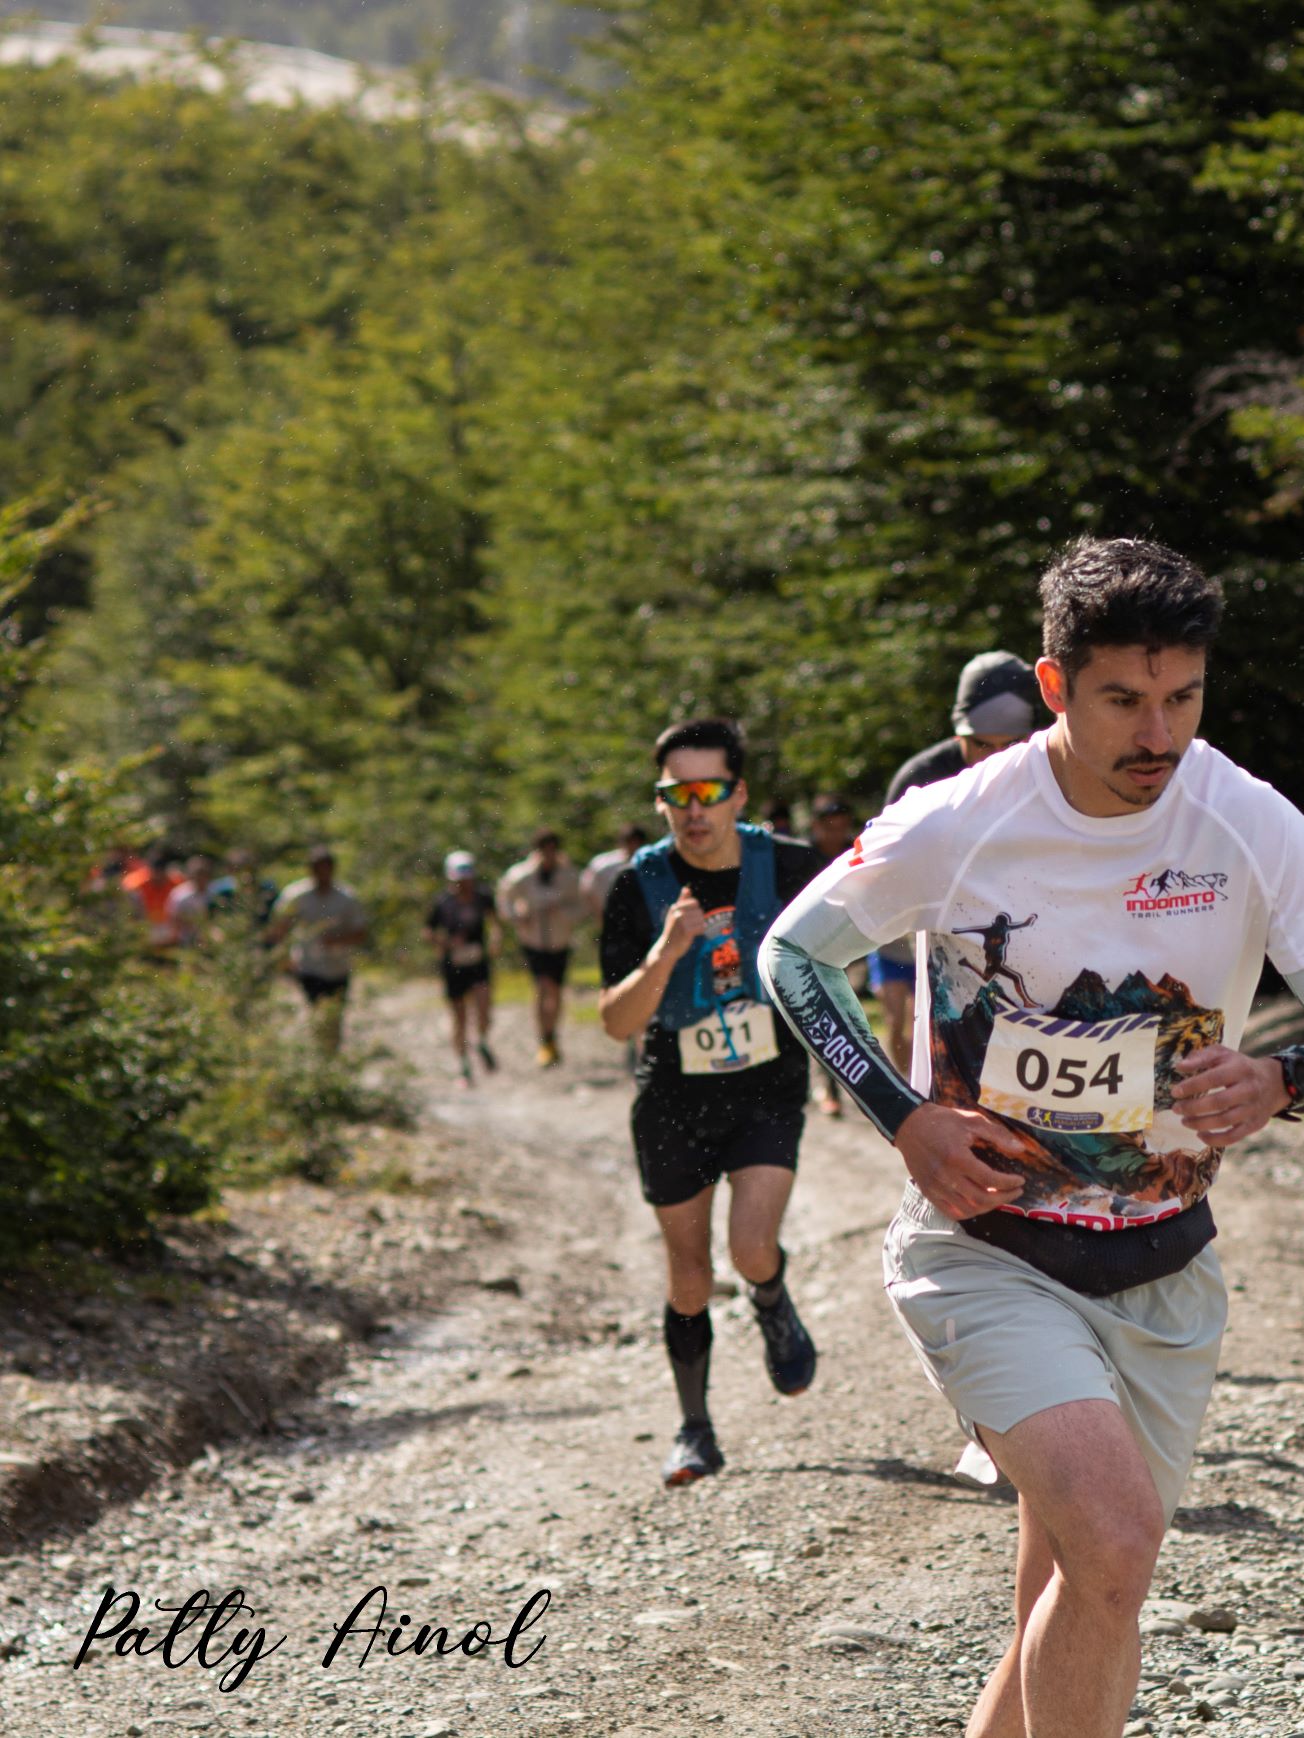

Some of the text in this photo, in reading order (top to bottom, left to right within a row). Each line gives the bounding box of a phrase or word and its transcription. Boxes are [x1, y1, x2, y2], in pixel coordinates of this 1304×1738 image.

[1126, 891, 1215, 911] INDOMITO
[1131, 904, 1214, 919] TRAIL RUNNERS
[1016, 1048, 1123, 1099] 054
